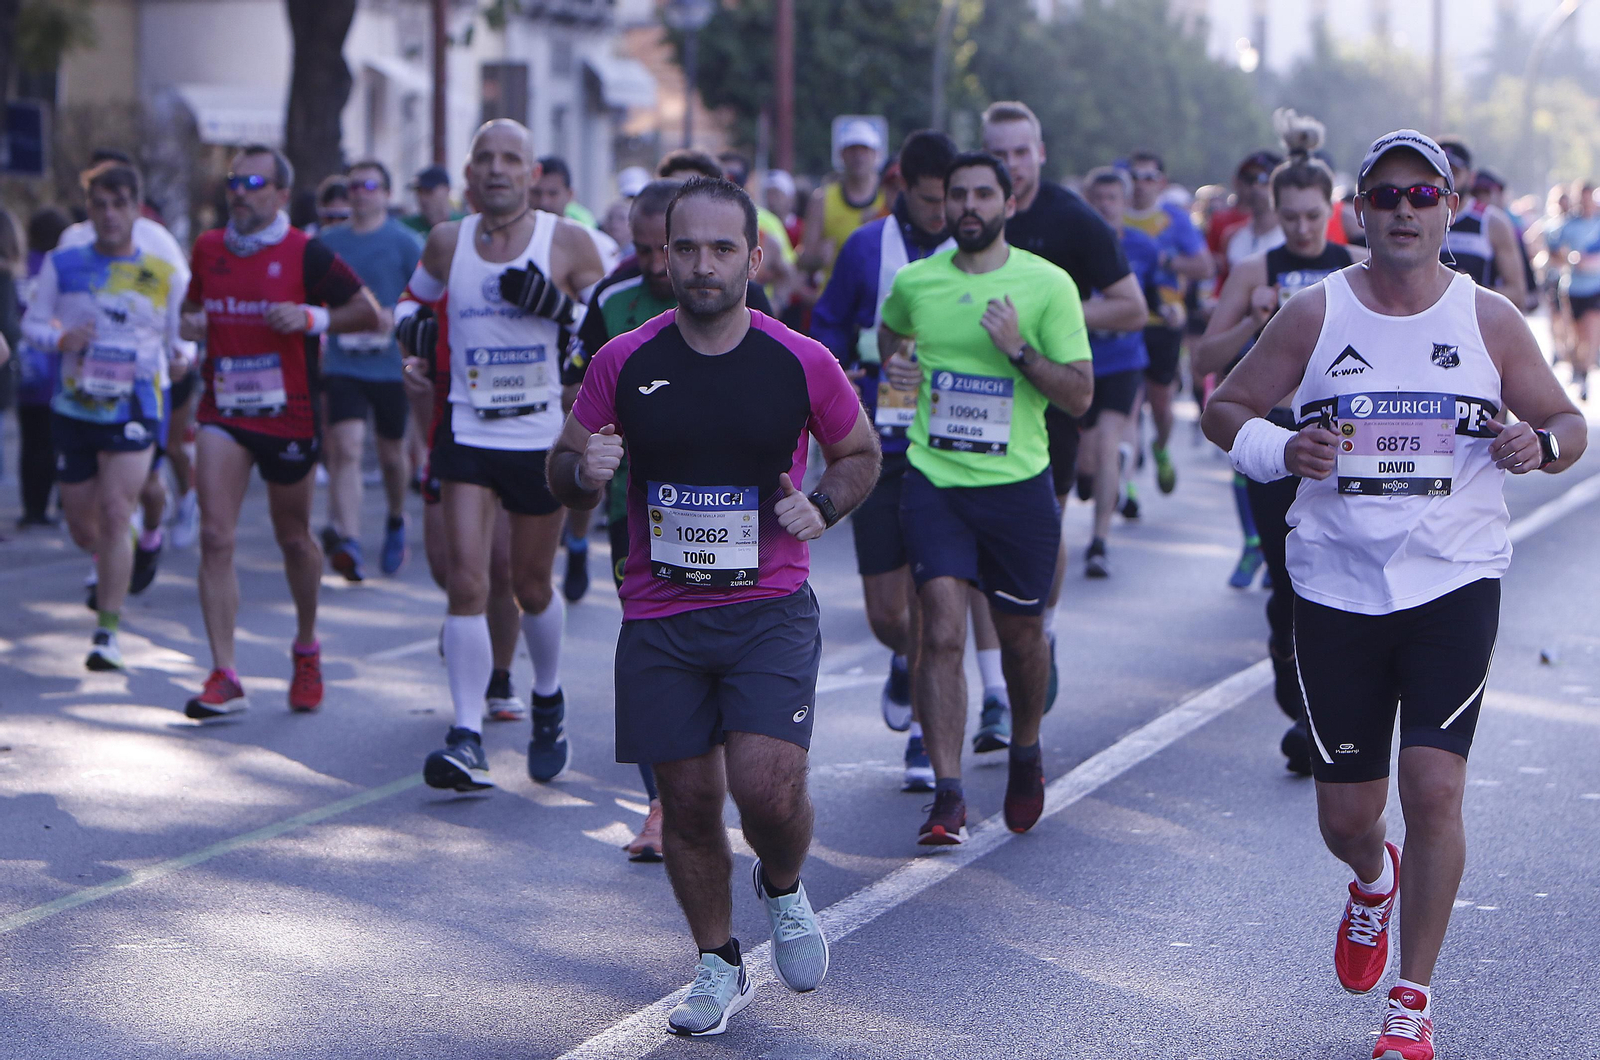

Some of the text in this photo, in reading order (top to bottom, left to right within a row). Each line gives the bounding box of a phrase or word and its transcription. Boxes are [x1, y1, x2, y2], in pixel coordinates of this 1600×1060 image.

[1372, 136, 1440, 154] TaylorMade
[492, 350, 539, 361] ZURICH
[1331, 367, 1366, 378] K-WAY
[954, 377, 1004, 393] ZURICH
[949, 405, 988, 420] 10904
[1377, 400, 1441, 414] ZURICH
[946, 423, 983, 437] CARLOS
[1376, 436, 1421, 451] 6875
[1378, 461, 1416, 473] DAVID
[680, 491, 744, 506] ZURICH
[676, 526, 729, 543] 10262
[682, 550, 716, 565] TOÑO
